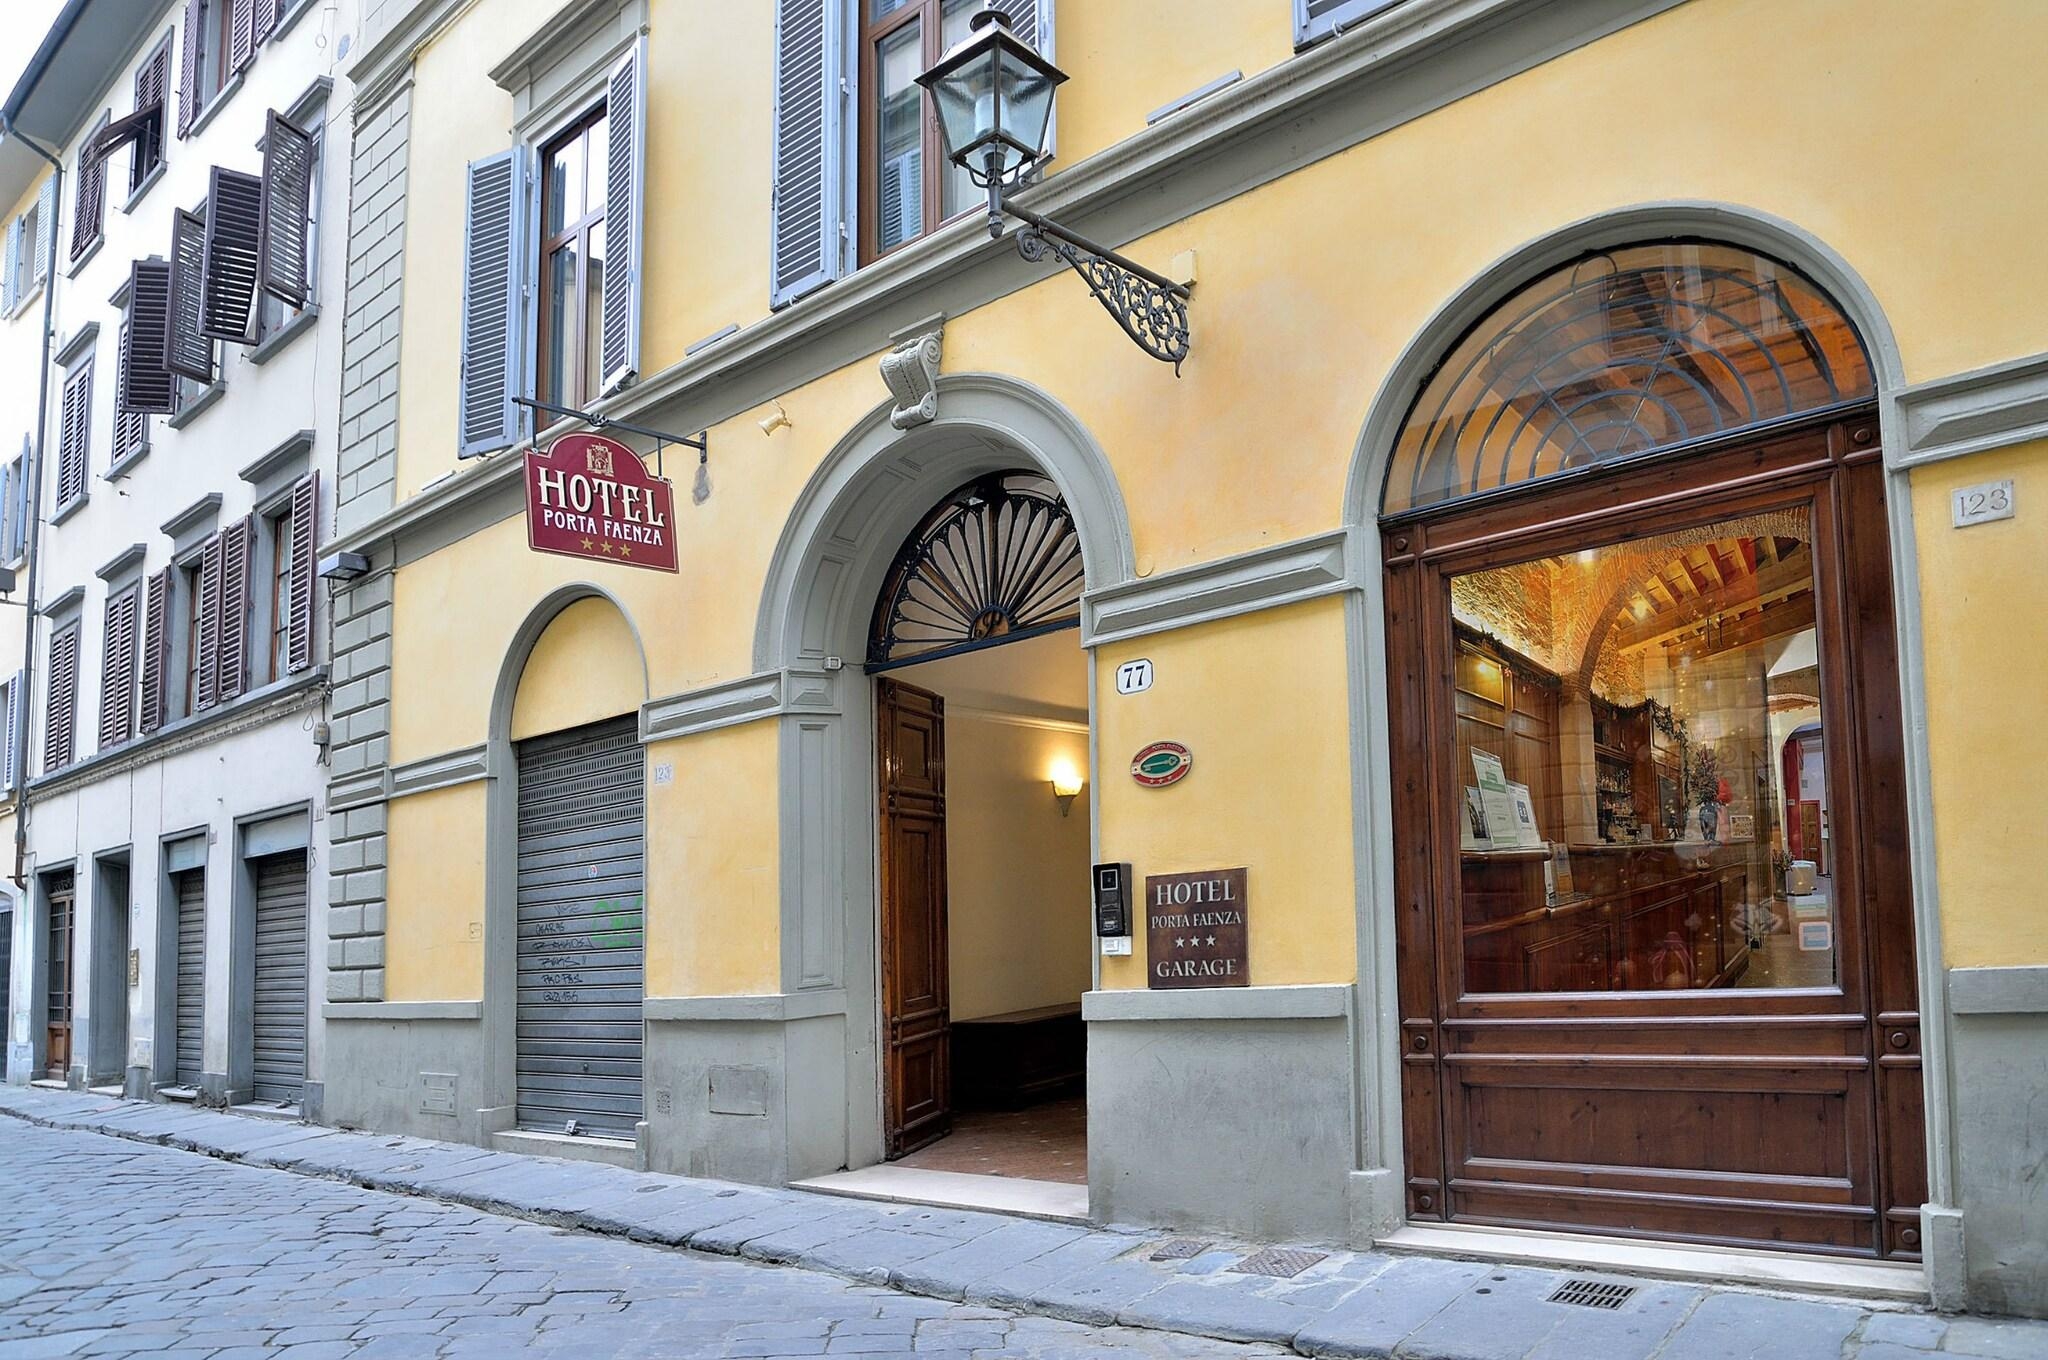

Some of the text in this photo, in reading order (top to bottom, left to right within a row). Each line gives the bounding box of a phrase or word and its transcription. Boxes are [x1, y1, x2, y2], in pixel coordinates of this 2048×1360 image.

[537, 466, 665, 527] HOTEL
[543, 509, 664, 546] PORTA FAENZA
[1123, 664, 1146, 689] 77
[1155, 879, 1236, 906] HOTEL
[1151, 911, 1242, 929] PORTA FAENZA
[1156, 958, 1238, 978] GARAGE
